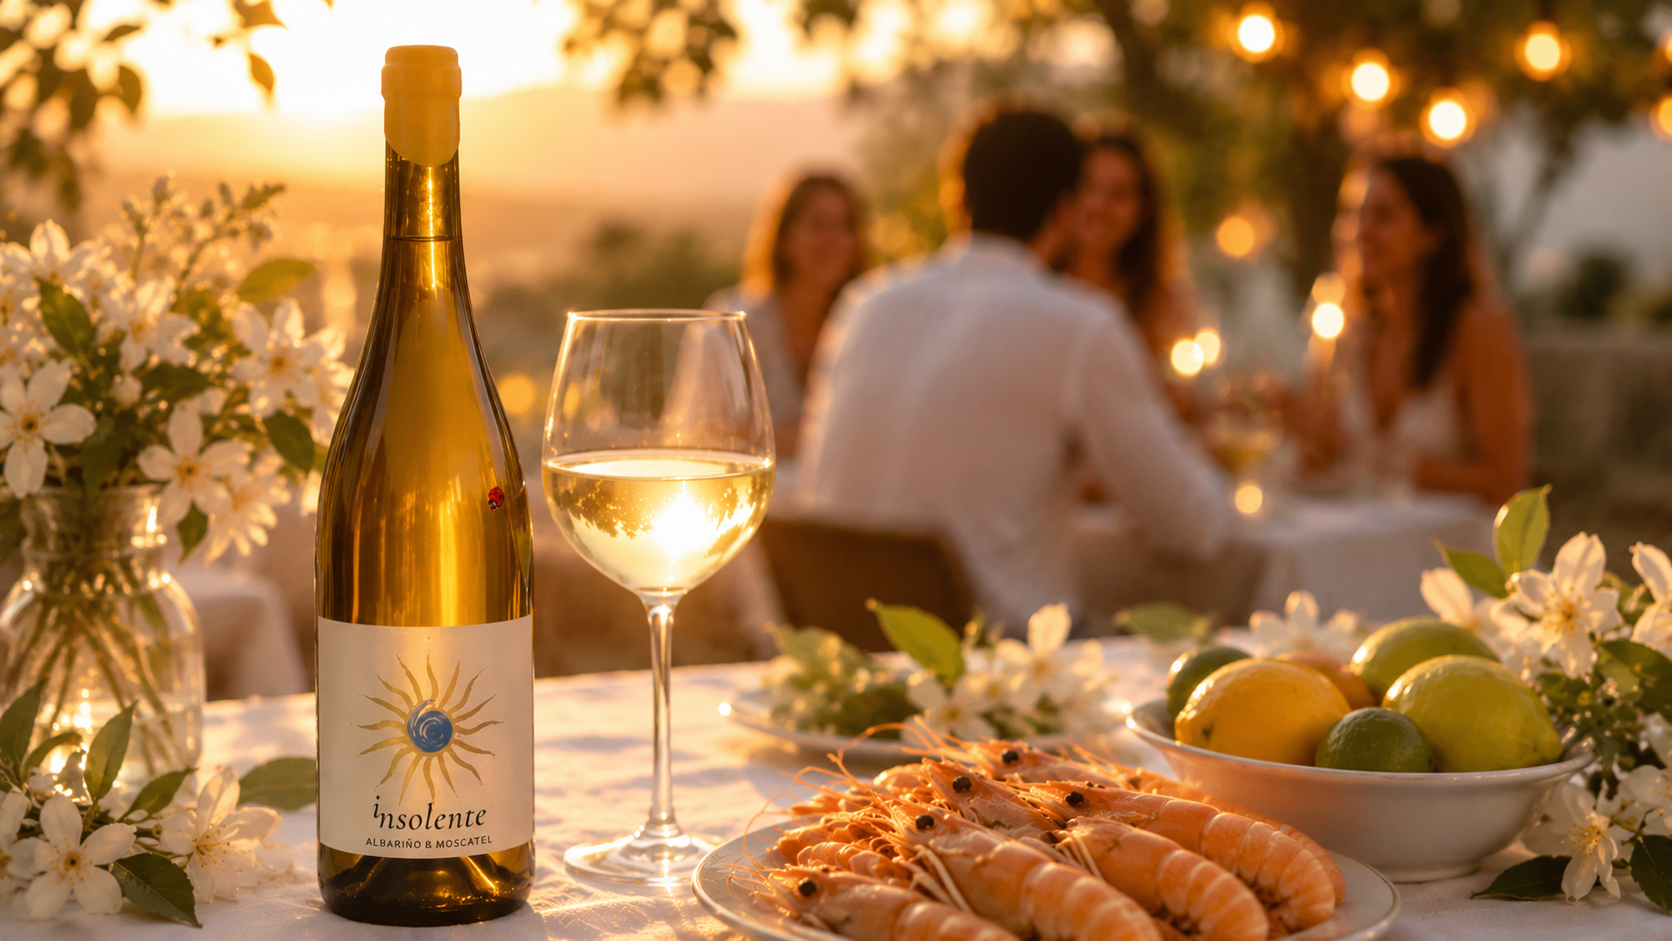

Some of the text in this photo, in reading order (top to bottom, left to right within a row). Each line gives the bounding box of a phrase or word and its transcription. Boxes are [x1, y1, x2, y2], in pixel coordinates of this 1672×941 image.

[372, 795, 487, 830] insolente
[365, 835, 493, 849] ALBARIÑO & MOSCATEL
